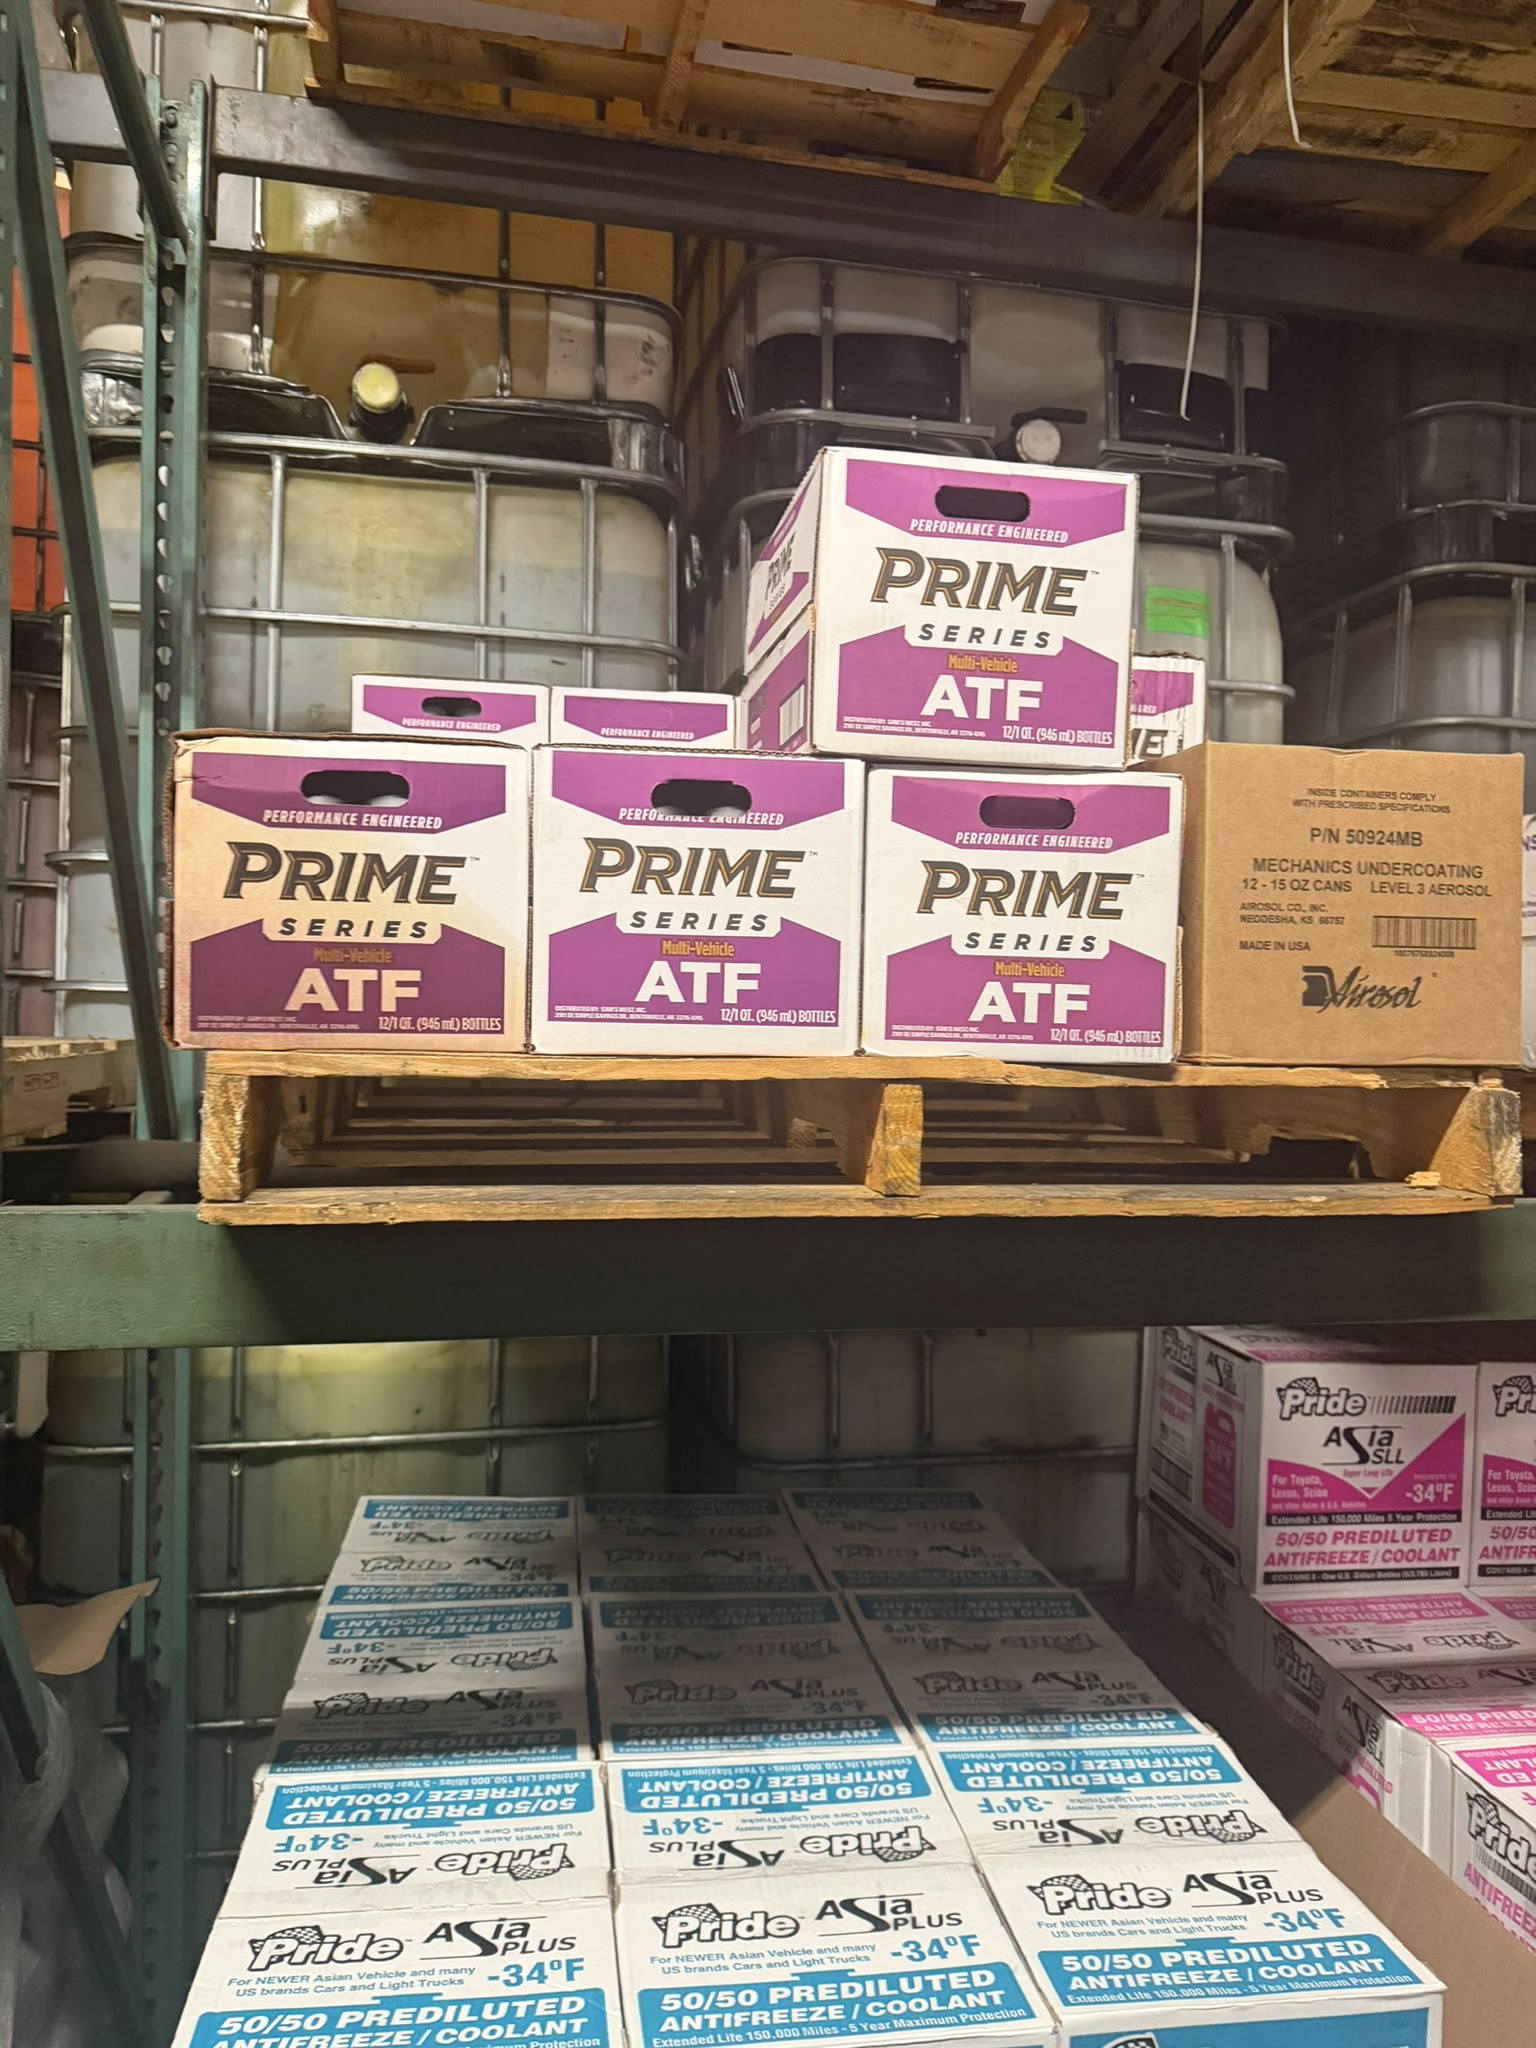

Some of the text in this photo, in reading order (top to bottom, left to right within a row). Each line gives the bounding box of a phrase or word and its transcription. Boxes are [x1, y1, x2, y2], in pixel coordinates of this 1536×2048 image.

[910, 519, 1068, 543] PERFORMANCE ENGINEERED
[870, 547, 1088, 616] PRIME
[918, 623, 1051, 648] SERIES
[948, 654, 1019, 672] Multi-Vehicle
[920, 675, 1043, 721] ATF
[402, 718, 501, 732] PERFORMANCE ENGINEERED
[601, 728, 694, 740] PERFORMANCE ENGINEERED
[1002, 725, 1112, 744] 12/1 QT. (946 mL) BOTTLES
[1307, 788, 1436, 801] INSIDE CONTAINERS COMPLY
[1292, 800, 1451, 813] WITH PRESCRIBED SPECIFICATIONS
[263, 810, 442, 829] PERFORMANCE ENGINEERED
[955, 832, 1113, 849] PERFORMANCE ENGINEERED
[1310, 828, 1423, 847] P/N 50924MB
[223, 841, 466, 905] PRIME
[579, 837, 805, 898] PRIME
[1253, 858, 1483, 878] MECHANICS UNDERCOATING
[916, 860, 1133, 920] PRIME
[1242, 879, 1257, 890] 12
[1270, 880, 1286, 890] 15
[1290, 880, 1309, 891] OZ
[1314, 881, 1352, 892] CANS
[1371, 882, 1492, 897] LEVEL 3 AEROSOL
[1240, 903, 1284, 912] AIROSOL
[1309, 904, 1328, 912] INC.
[278, 918, 427, 939] SERIES
[630, 911, 768, 931] SERIES
[1300, 916, 1313, 924] KS
[661, 939, 735, 957] Multi-Vehicle
[964, 932, 1097, 952] SERIES
[1239, 941, 1311, 951] MADE IN USA
[313, 948, 392, 963] Multi-Vehicle
[995, 961, 1065, 977] Multi-Vehicle
[283, 968, 421, 1012] ATF
[634, 961, 761, 1004] ATF
[1318, 966, 1422, 1013] Airosol
[968, 981, 1090, 1024] ATF
[721, 1008, 835, 1023] 12/1 QT. (946 mL) BOTTLES
[1051, 1029, 1161, 1044] 12/1 QT. (946 mL) BOTTLES
[1278, 1385, 1367, 1421] Pride
[1371, 1448, 1405, 1464] SLL
[1273, 1475, 1322, 1485] For Toyota,
[1272, 1487, 1328, 1499] Lexus, Scion
[1272, 1515, 1310, 1524] Extended
[1313, 1514, 1328, 1523] Life
[1364, 1513, 1385, 1522] Miles
[1417, 1513, 1457, 1521] Protection
[1276, 1529, 1453, 1547] 50/50 PREDILUTED
[1265, 1551, 1370, 1567] ANTIFREEZE
[1382, 1548, 1460, 1562] COOLANT
[966, 1769, 1223, 1789] 50/50 PREDILUTED
[283, 1798, 577, 1826] 50/50 PREDILUTED
[1135, 1810, 1255, 1838] Pride
[800, 1826, 922, 1857] Pride
[435, 1843, 570, 1876] Pride
[1040, 1880, 1172, 1915] Pride
[1259, 1889, 1323, 1905] PLUS
[661, 1911, 800, 1948] Pride
[893, 1912, 962, 1931] PLUS
[247, 1932, 404, 1971] Pride
[500, 1936, 576, 1956] PLUS
[650, 1943, 876, 1965] For NEWER Asian Vehicle and many
[1062, 1939, 1371, 1972] 50/50 PREDILUTED
[661, 1954, 871, 1975] US brands Cars and Light Trucks
[1069, 1971, 1242, 1991] ANTIFREEZE
[1258, 1958, 1385, 1981] COOLANT
[660, 1969, 996, 2012] 50/50 PREDILUTED
[217, 1997, 586, 2035] 50/50 PREDILUTED
[659, 2004, 846, 2032] ANTIFREEZE
[866, 1990, 1005, 2017] COOLANT
[652, 2035, 714, 2048] Extended
[717, 2032, 743, 2043] Life
[803, 2024, 839, 2037] Miles
[849, 2023, 858, 2034] 5
[860, 2019, 891, 2032] Year
[894, 2014, 958, 2029] Maximum
[961, 2007, 1027, 2024] Protection
